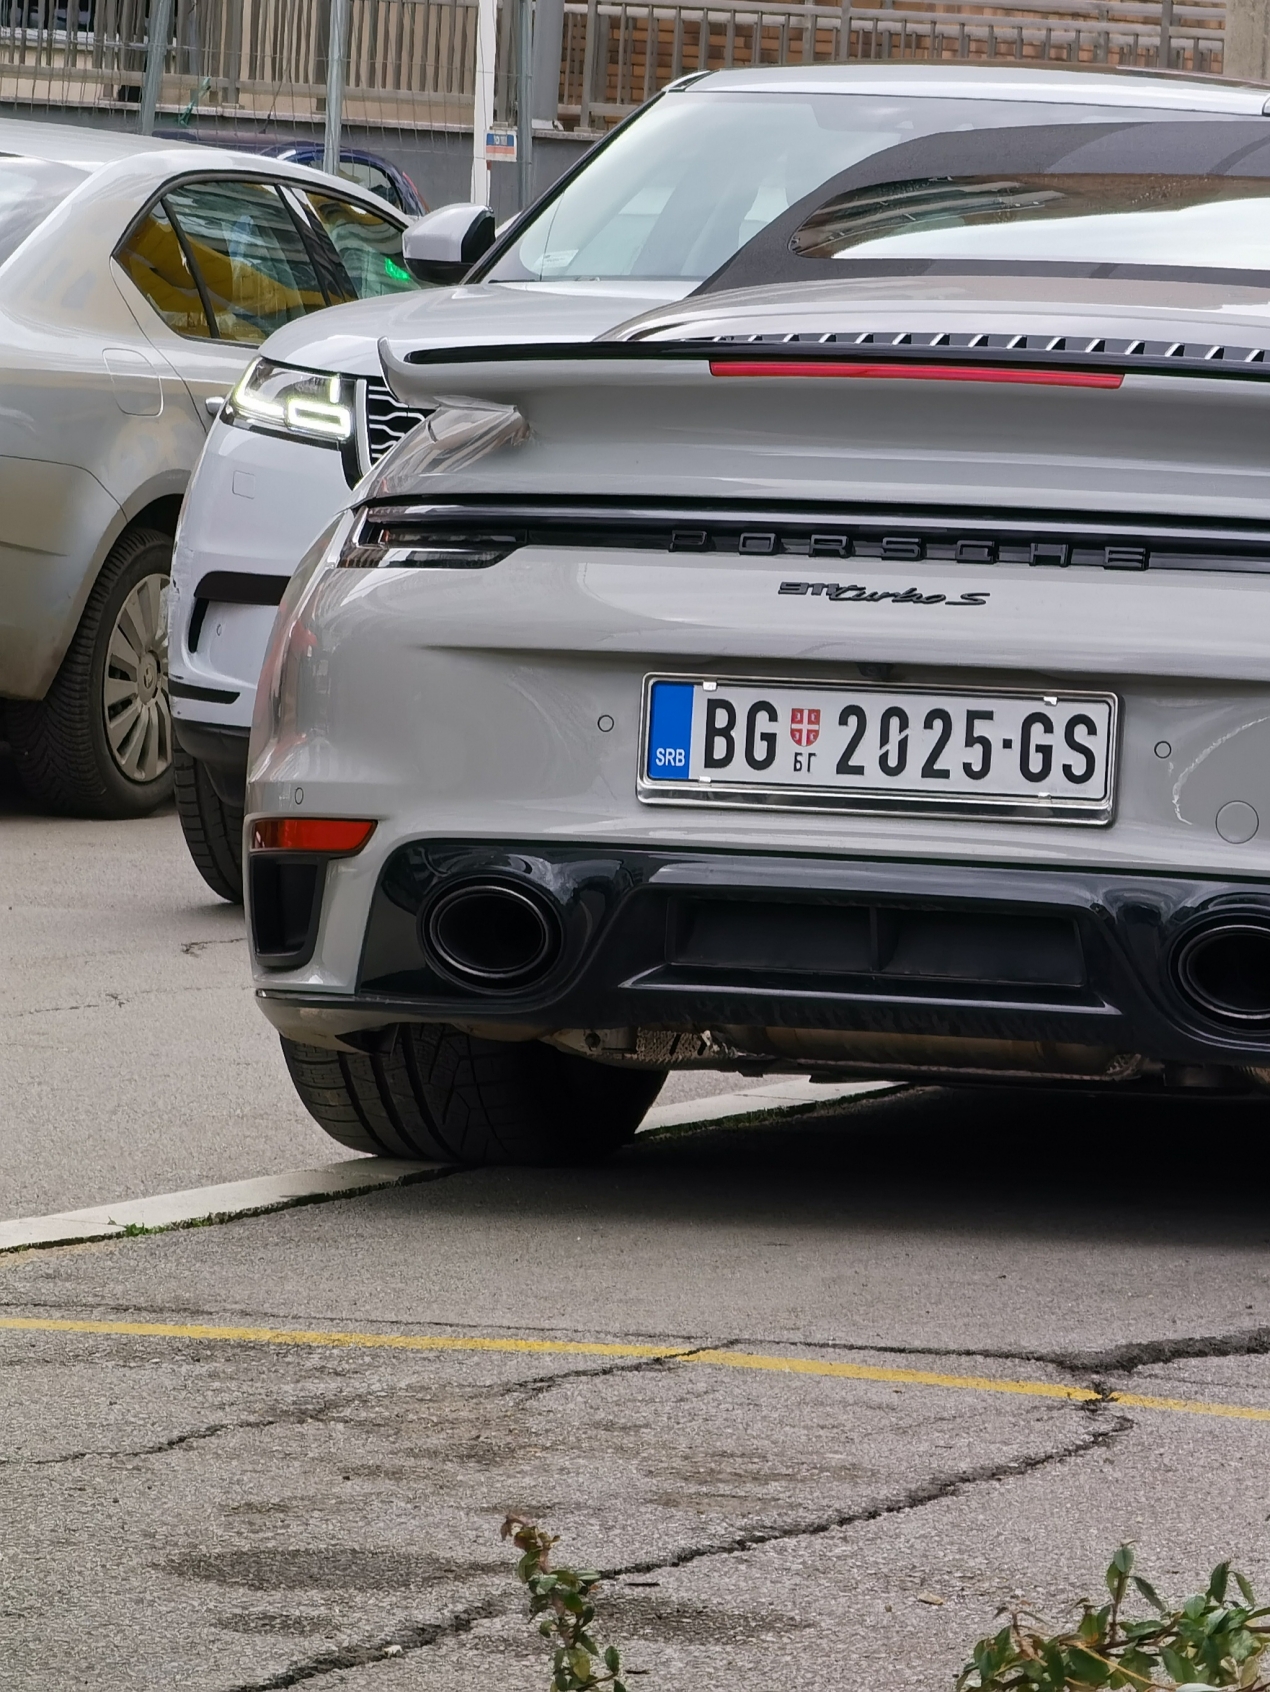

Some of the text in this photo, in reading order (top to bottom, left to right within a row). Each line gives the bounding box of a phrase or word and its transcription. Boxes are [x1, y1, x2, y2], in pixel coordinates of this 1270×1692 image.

[668, 530, 1149, 571] PORSCHE
[945, 592, 990, 606] S
[704, 698, 778, 771] BG
[655, 747, 686, 767] SRB
